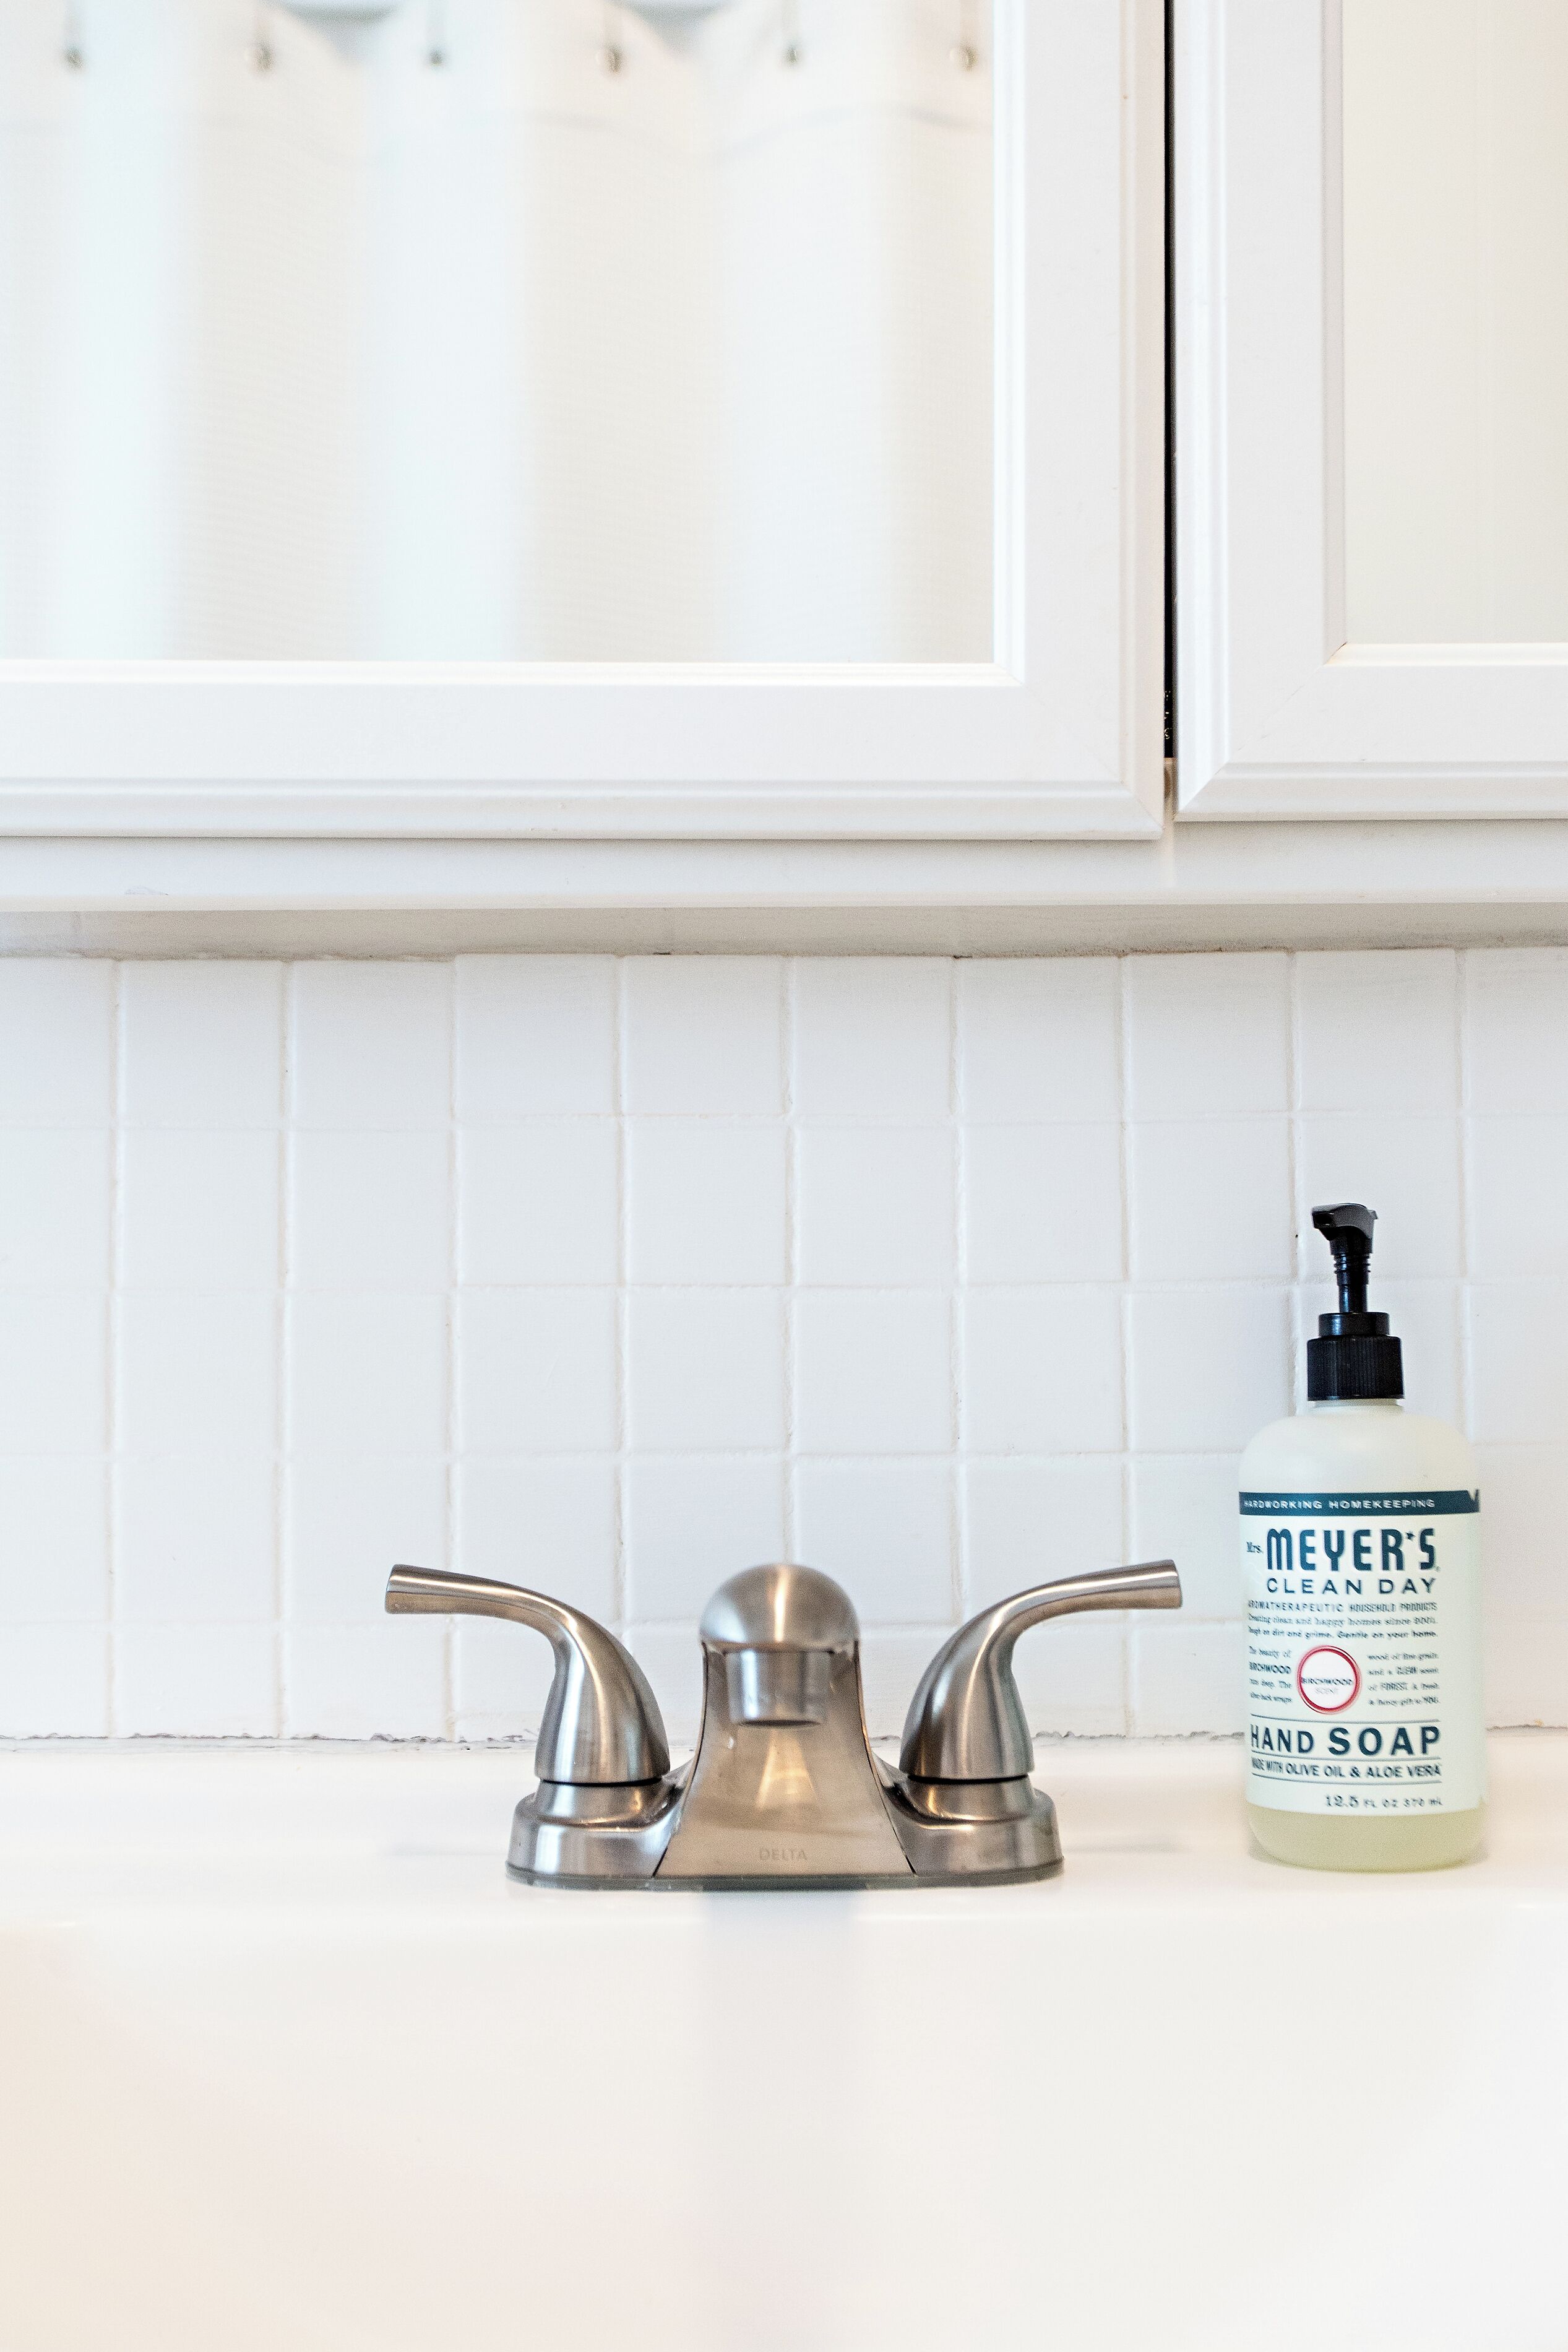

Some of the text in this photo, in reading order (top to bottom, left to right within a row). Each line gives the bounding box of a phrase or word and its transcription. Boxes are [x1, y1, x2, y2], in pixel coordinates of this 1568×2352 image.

[1244, 1499, 1436, 1509] HARDWORKING HOMEKEEPING
[1267, 1578, 1436, 1595] CLEAN DAY
[1247, 1600, 1344, 1612] AROMATHERAPEUTIC
[1349, 1602, 1395, 1612] HOUSEHOLD
[1314, 1617, 1345, 1628] happy
[1348, 1617, 1382, 1625] homes
[1387, 1632, 1409, 1640] your
[1251, 1723, 1442, 1756] HAND SOAP
[1286, 1763, 1320, 1776] OLIVE
[1324, 1765, 1346, 1778] OIL
[1350, 1766, 1361, 1778] &
[1366, 1766, 1403, 1778] ALOE
[1406, 1763, 1442, 1778] VERA
[1325, 1794, 1359, 1809] 12.5
[759, 1848, 808, 1861] DELTA
